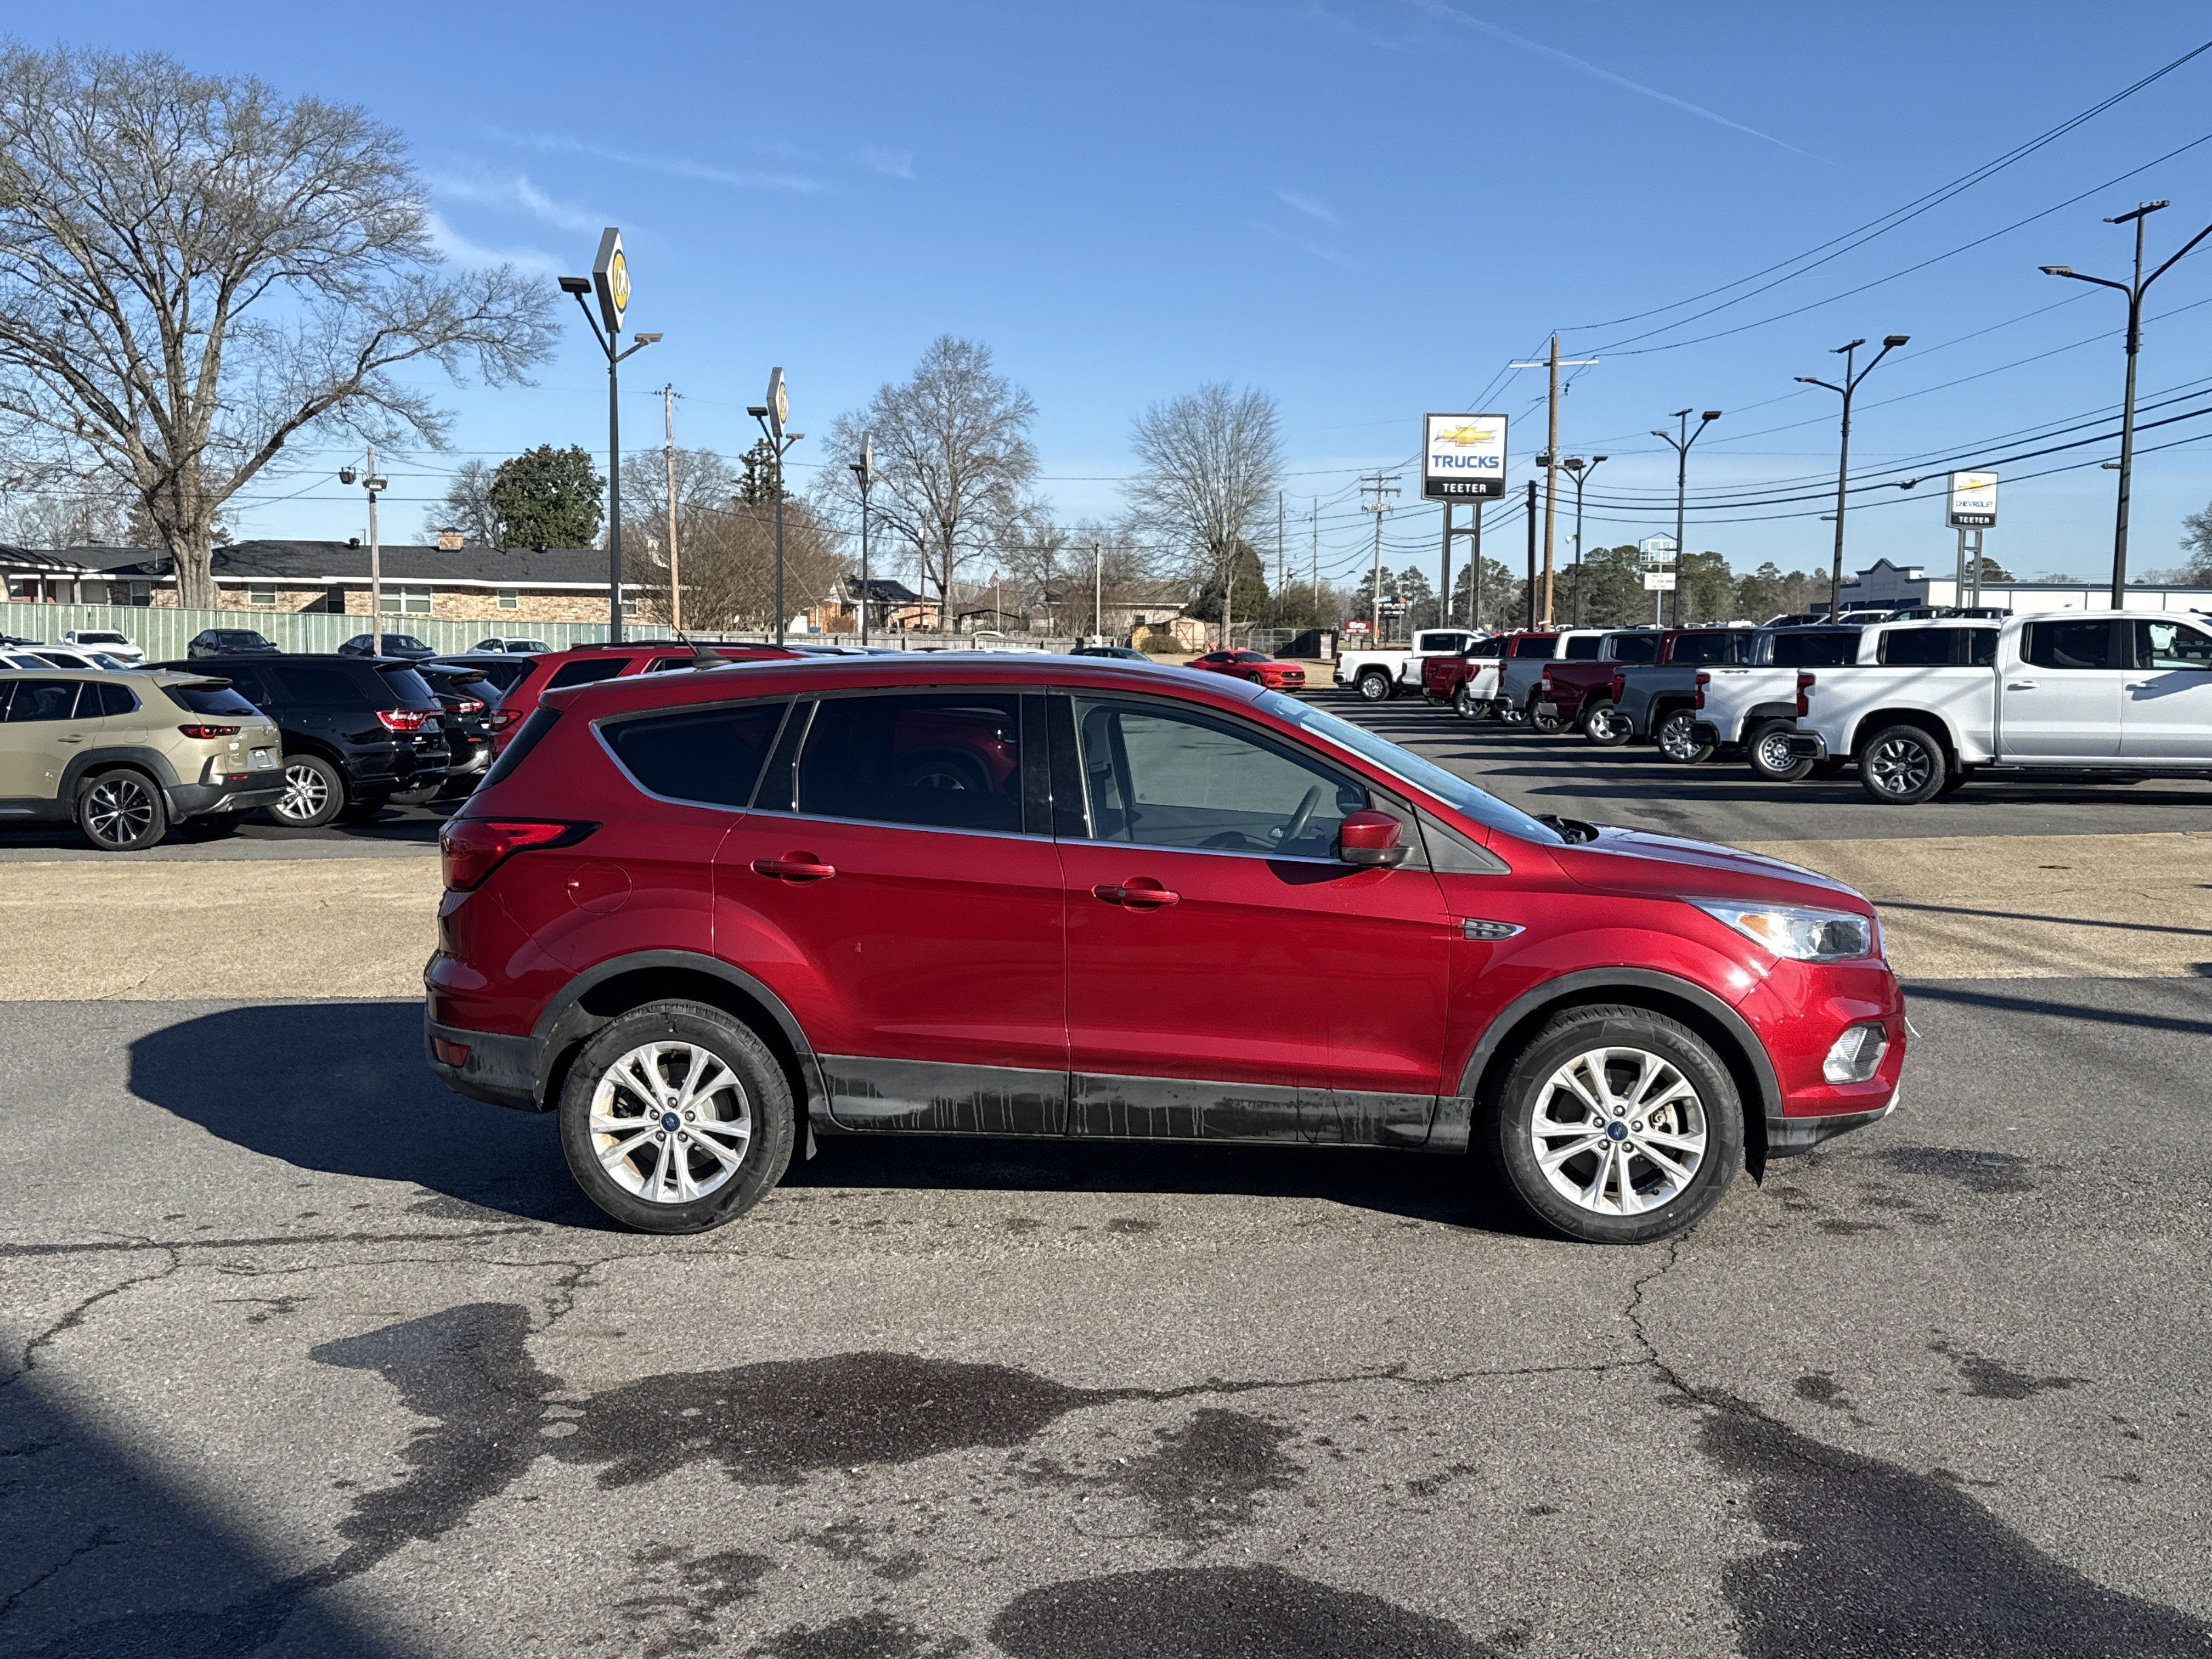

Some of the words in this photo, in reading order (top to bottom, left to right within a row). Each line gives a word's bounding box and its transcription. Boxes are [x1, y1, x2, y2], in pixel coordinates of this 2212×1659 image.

[1432, 455, 1499, 469] TRUCKS
[1442, 483, 1486, 493] TEETER
[1959, 516, 1990, 524] TEETER
